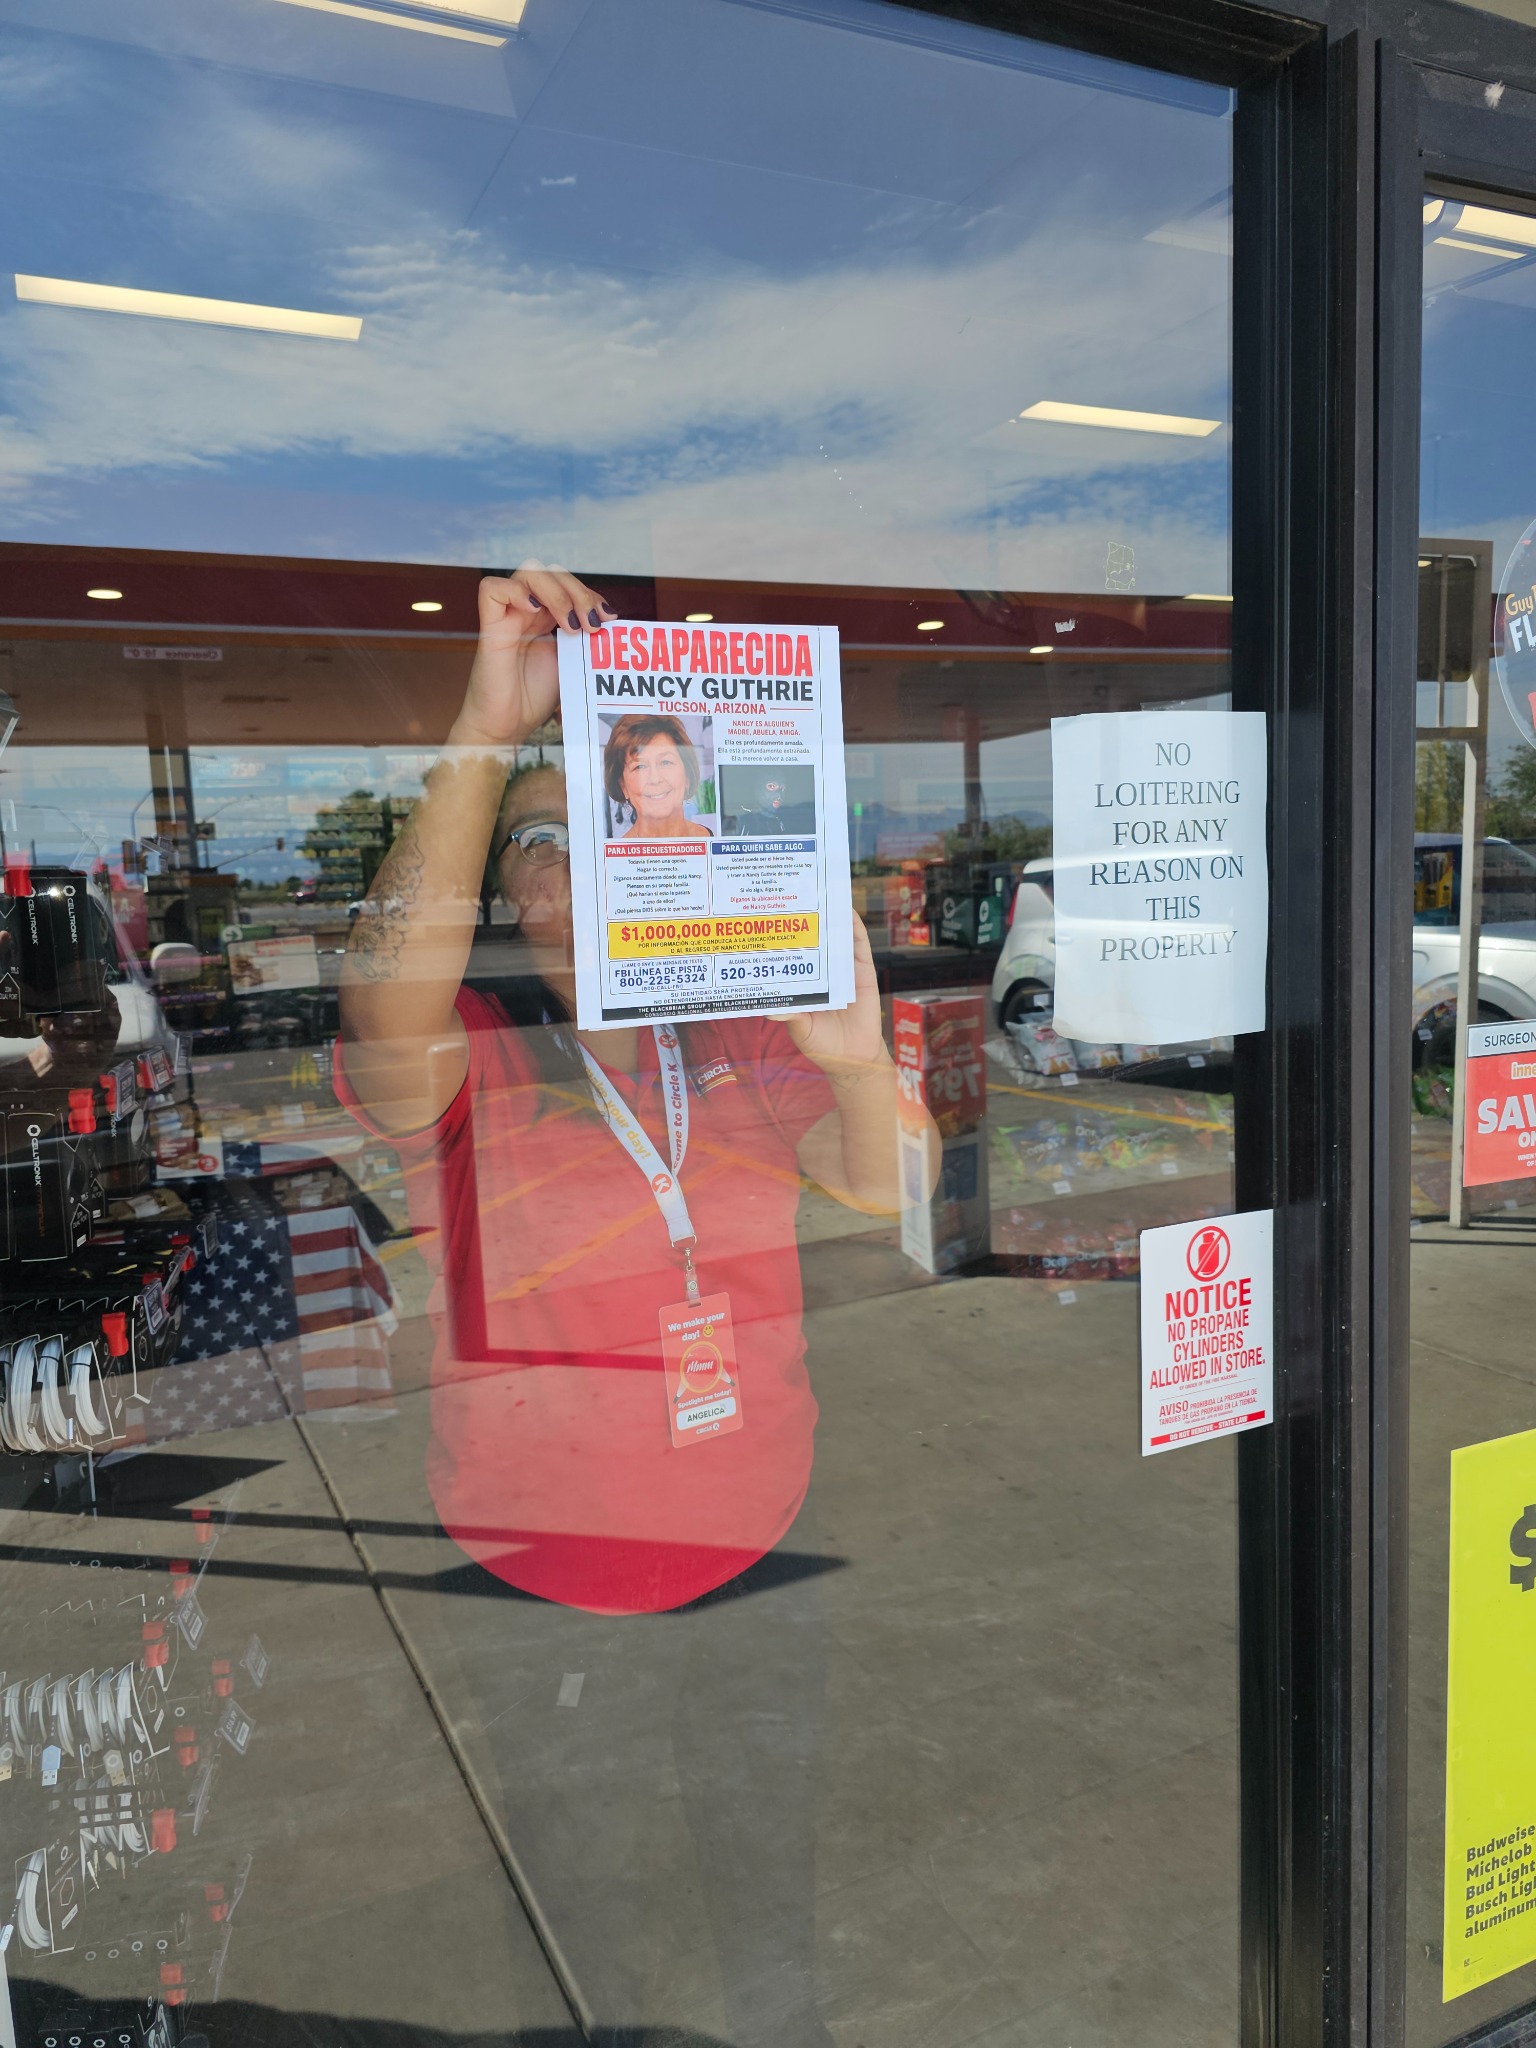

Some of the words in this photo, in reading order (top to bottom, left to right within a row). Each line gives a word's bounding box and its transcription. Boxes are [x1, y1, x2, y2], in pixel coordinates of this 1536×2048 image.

[1506, 593, 1534, 616] Guy
[589, 626, 813, 677] DESAPARECIDA
[595, 674, 692, 698] NANCY
[701, 678, 814, 701] GUTHRIE
[658, 701, 710, 715] TUCSON,
[714, 702, 766, 714] ARIZONA
[1155, 742, 1191, 766] NO
[1094, 780, 1240, 807] LOITERING
[1112, 821, 1169, 846] FOR
[1174, 819, 1228, 843] ANY
[642, 846, 704, 854] SECUESTRADORES.
[742, 844, 763, 852] QUIEN
[1089, 857, 1202, 886] REASON
[1210, 856, 1244, 880] ON
[68, 898, 78, 943] CELLTRONIX
[1146, 895, 1200, 921] THIS
[28, 900, 38, 945] CELLTRONIX
[621, 923, 711, 942] $1,000,000
[716, 918, 809, 936] RECOMPENSA
[1100, 931, 1238, 961] PROPERTY
[620, 973, 705, 987] 800-225-5324
[634, 967, 662, 976] LÍNEA
[679, 965, 707, 974] PISTAS
[720, 962, 814, 980] 520-351-4900
[1484, 1031, 1536, 1048] SURGEON
[667, 1063, 677, 1072] K
[697, 1063, 732, 1085] CIRCLE
[669, 1074, 682, 1109] Circle
[607, 1100, 630, 1129] your
[626, 1129, 651, 1159] day!
[674, 1113, 682, 1127] to
[32, 1138, 42, 1186] CELLTRONIX
[1165, 1277, 1251, 1321] NOTICE
[668, 1324, 681, 1332] We
[683, 1317, 704, 1328] make
[706, 1312, 725, 1324] your
[1168, 1322, 1185, 1342] NO
[1191, 1309, 1249, 1337] PROPANE
[682, 1330, 700, 1342] day!
[1174, 1331, 1244, 1362] CYLINDERS
[1150, 1360, 1206, 1389] ALLOWED
[1210, 1356, 1221, 1376] IN
[1226, 1347, 1265, 1372] STORE.
[687, 1407, 725, 1422] ANGELICA
[1160, 1400, 1188, 1417] AVISO
[1190, 1398, 1215, 1410] PROHIBIDA
[1224, 1390, 1250, 1401] PRESENCIA
[1160, 1415, 1180, 1425] TANQUES
[1182, 1412, 1188, 1420] DE
[1190, 1409, 1199, 1418] GAS
[1201, 1405, 1223, 1416] PROPANO
[1179, 1430, 1190, 1439] NOT
[1191, 1423, 1213, 1436] REMOVE
[1218, 1418, 1235, 1429] STATE
[1236, 1416, 1247, 1425] LAW
[1466, 1825, 1535, 1862] Budweise
[1466, 1843, 1532, 1881] Michelob
[1466, 1876, 1494, 1901] Bud
[1498, 1860, 1535, 1886] Light
[1466, 1891, 1507, 1920] Busch
